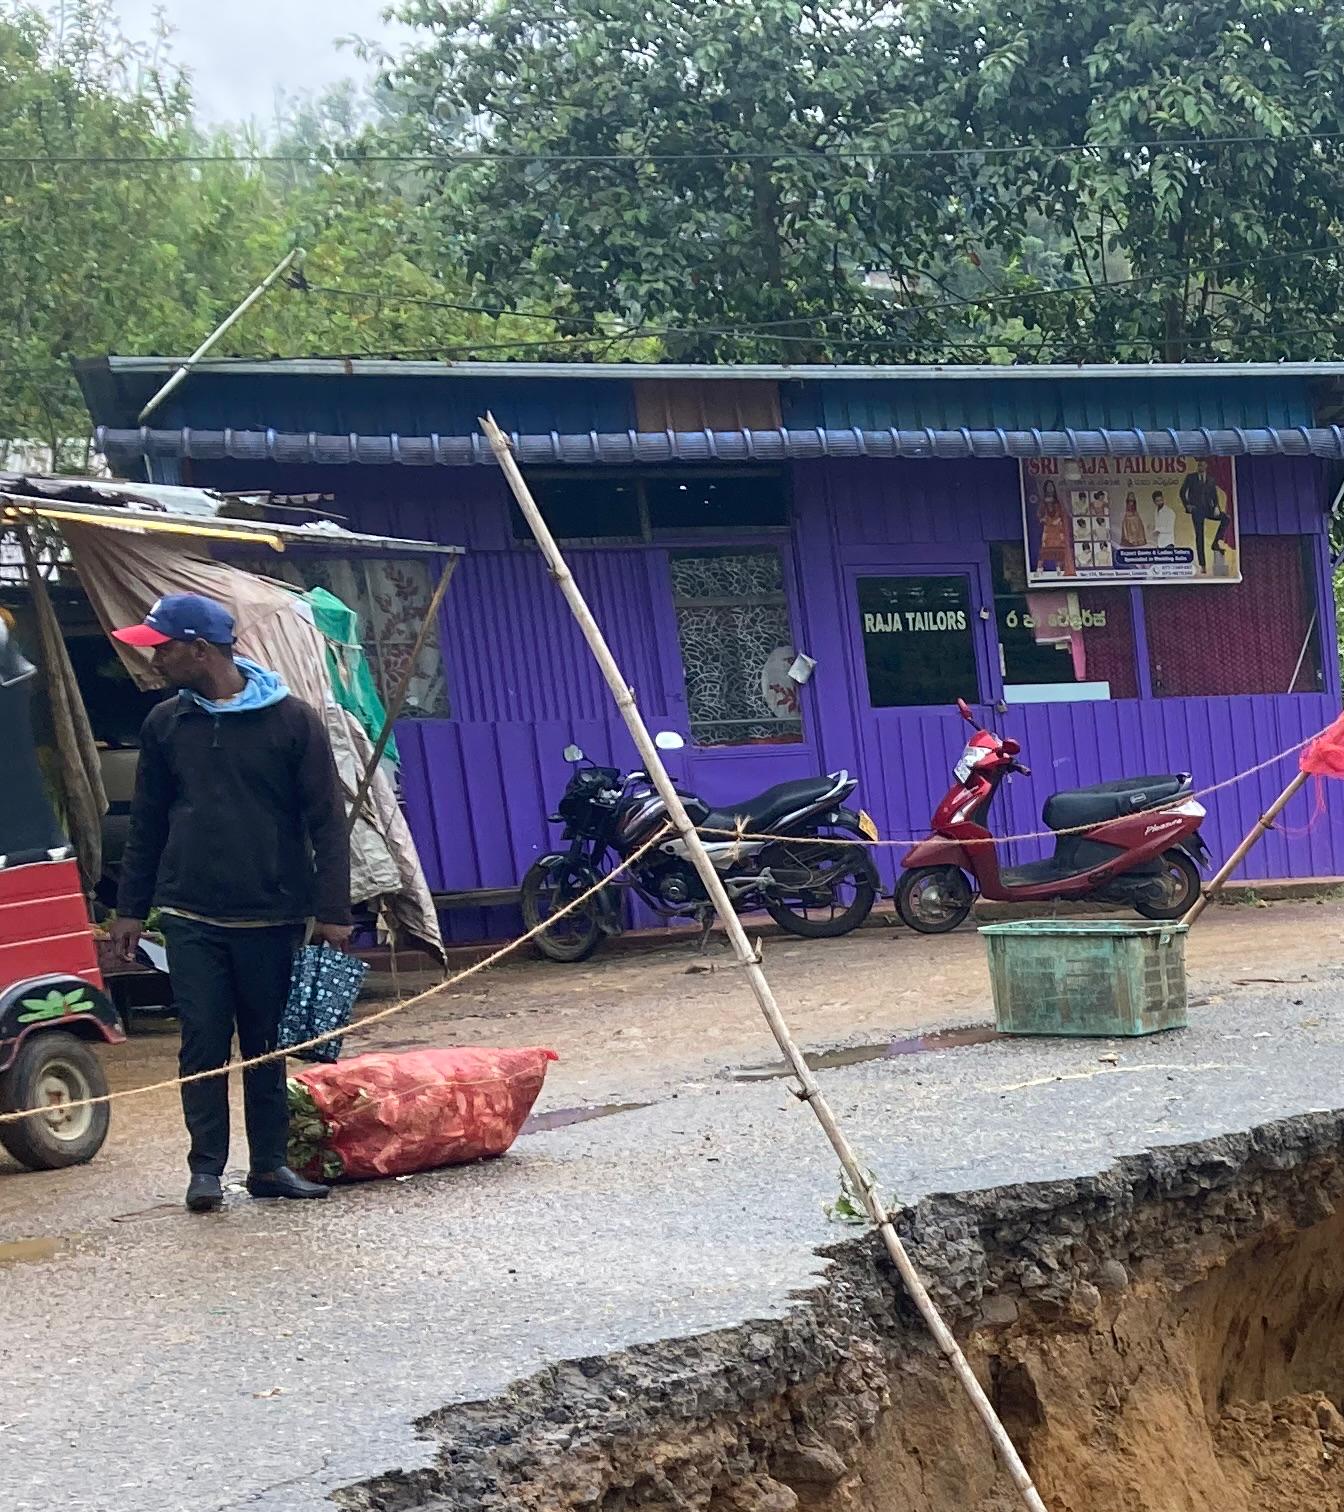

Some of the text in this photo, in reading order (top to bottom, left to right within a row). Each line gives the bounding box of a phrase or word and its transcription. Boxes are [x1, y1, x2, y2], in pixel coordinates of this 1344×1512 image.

[1028, 456, 1187, 475] SRI AJA TAILORS
[864, 610, 967, 633] RAJA TAILORS
